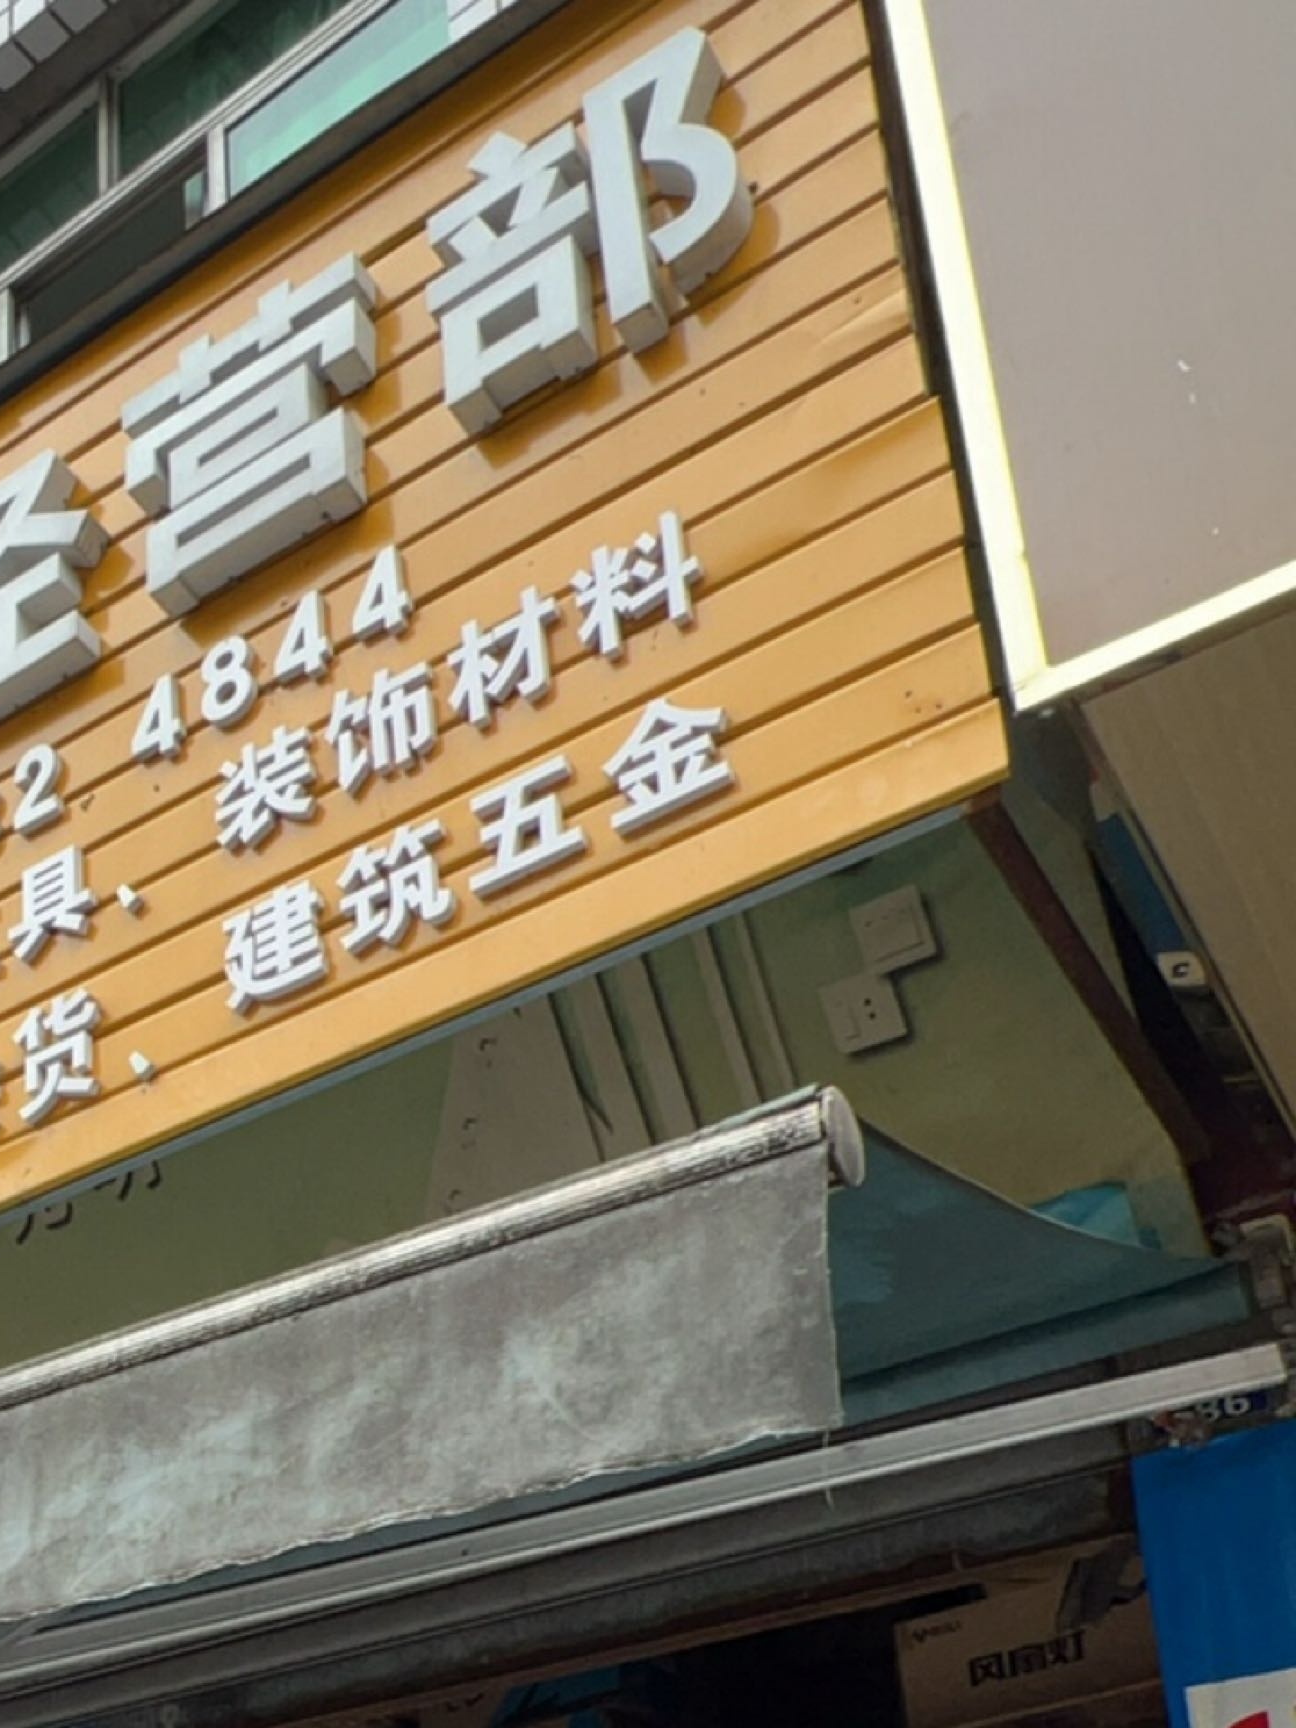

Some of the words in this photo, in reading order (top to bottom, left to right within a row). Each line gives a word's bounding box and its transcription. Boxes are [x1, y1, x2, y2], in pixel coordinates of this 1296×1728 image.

[129, 543, 412, 764] 4844
[212, 508, 699, 853] 装饰材料
[221, 693, 735, 1016] 建筑五金
